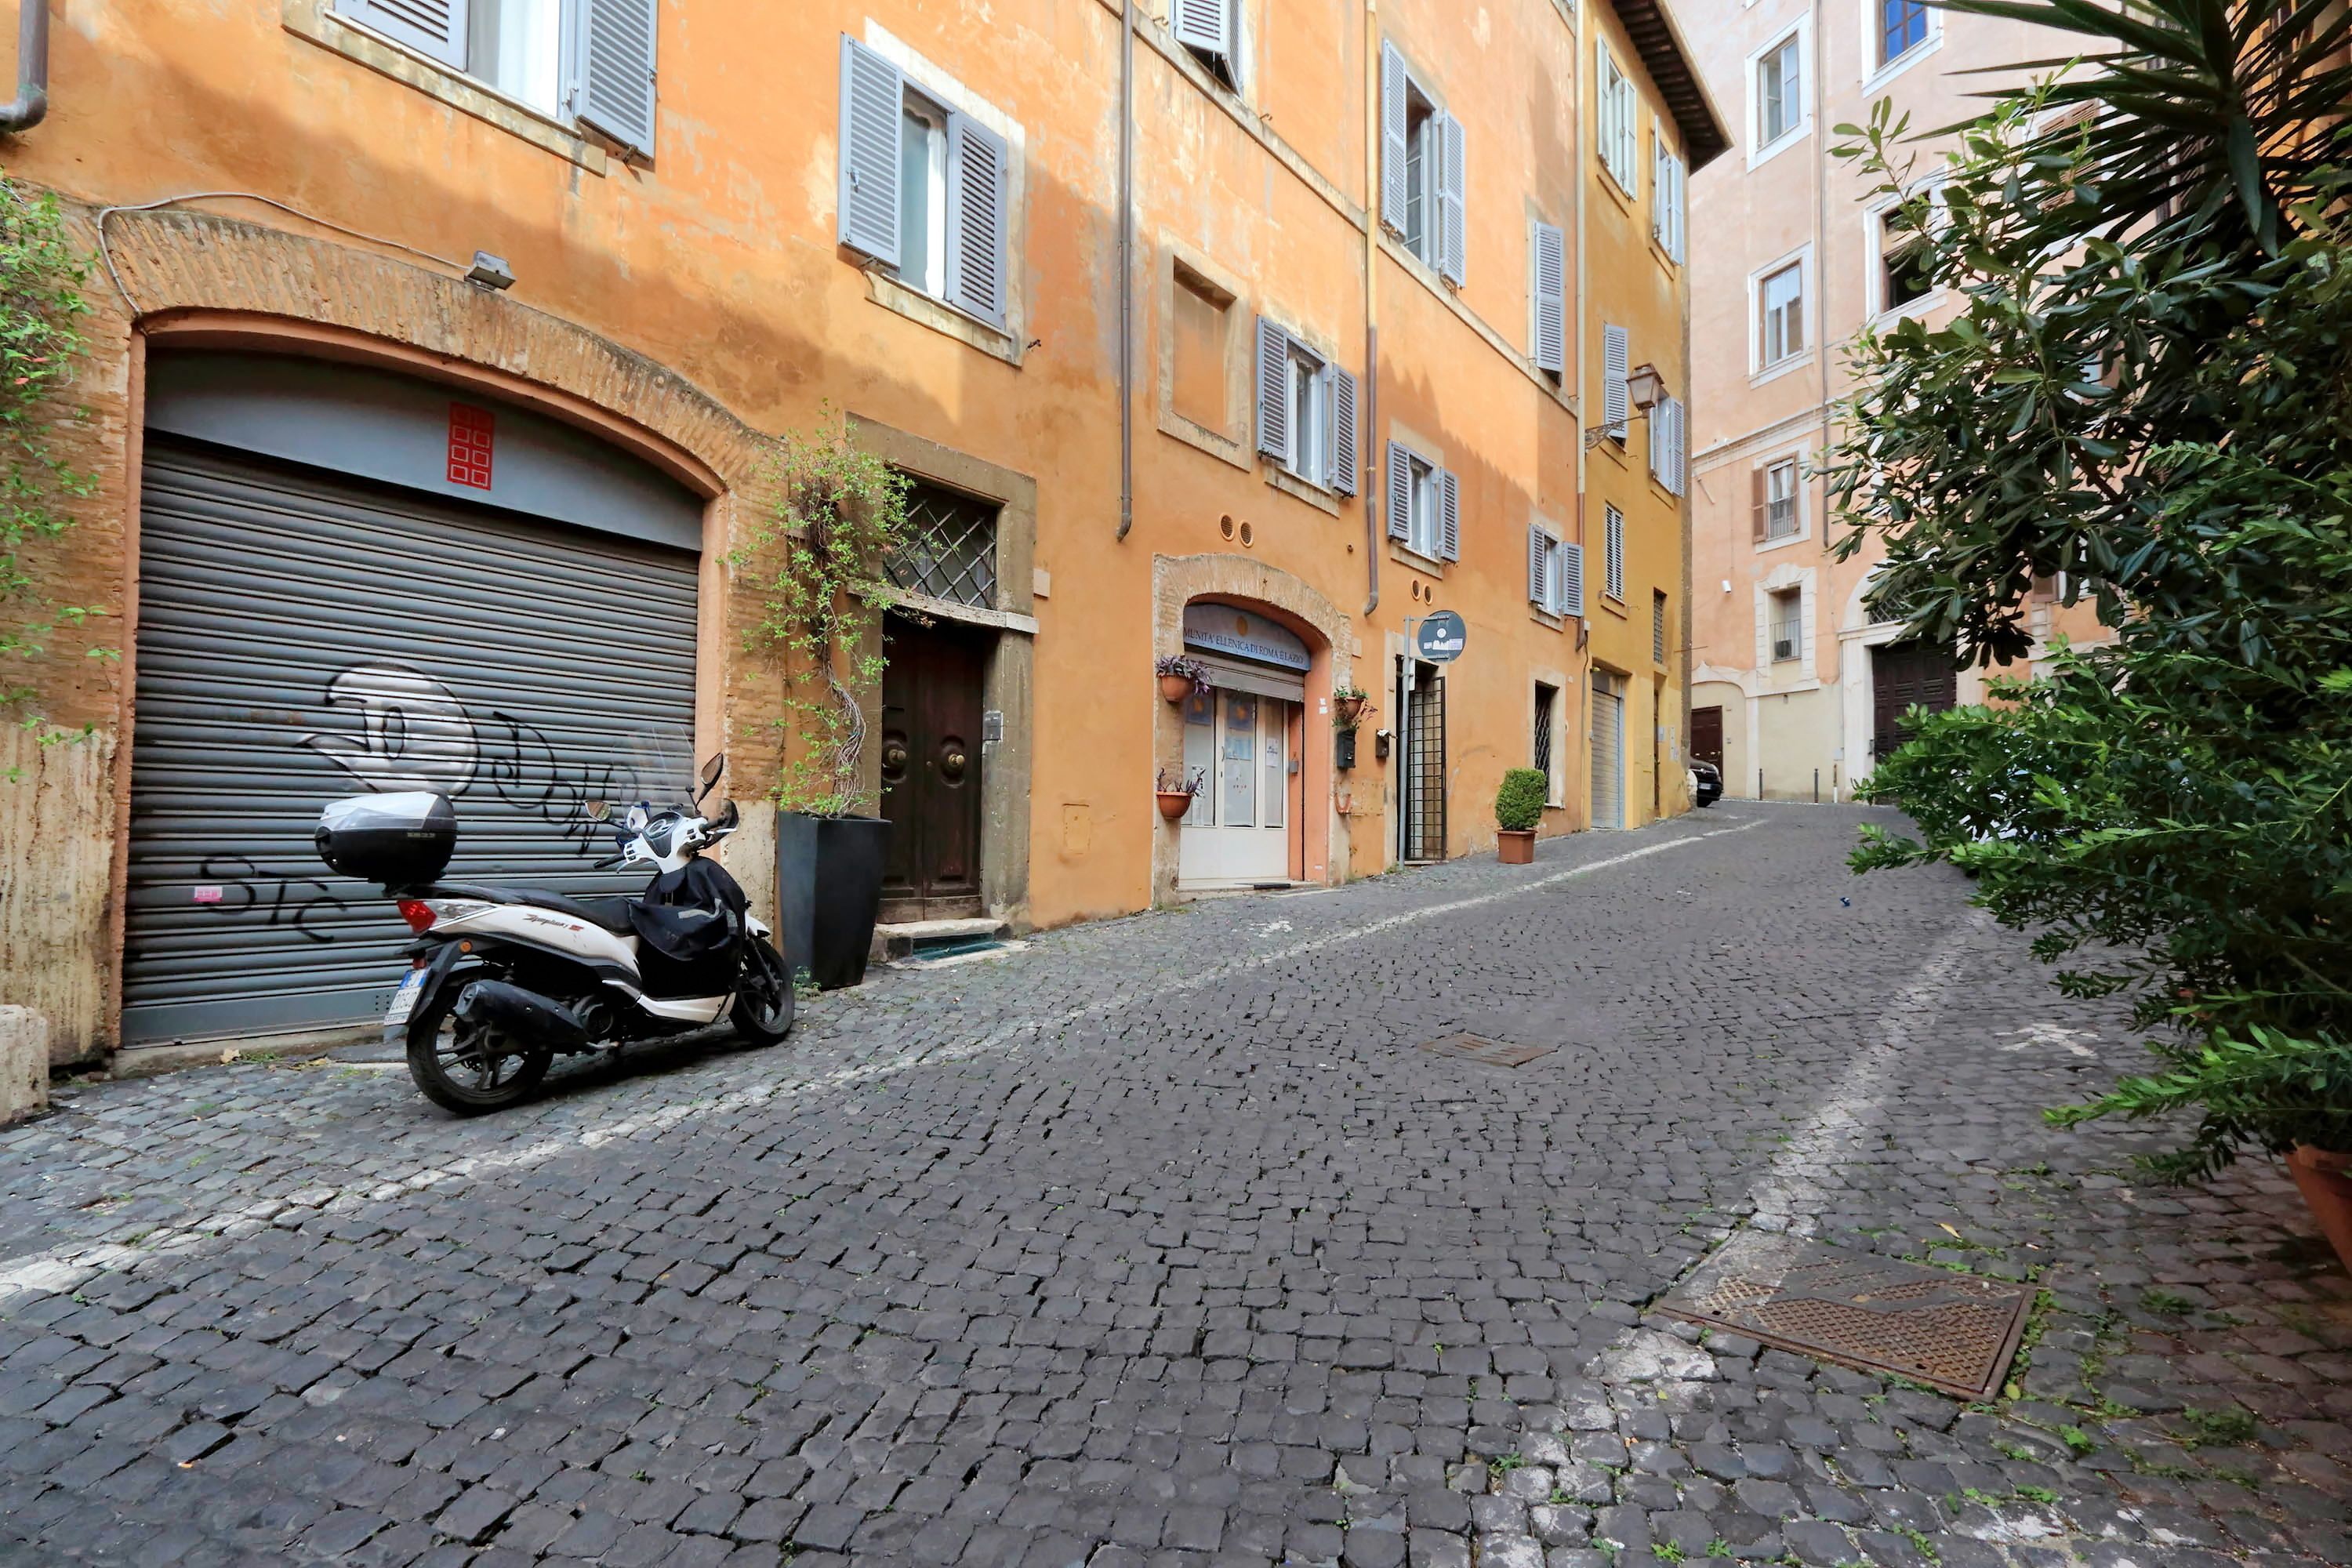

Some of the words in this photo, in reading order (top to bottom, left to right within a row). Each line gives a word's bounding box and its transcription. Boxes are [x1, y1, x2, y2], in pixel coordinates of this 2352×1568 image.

[1216, 634, 1250, 652] ELLENICA
[1250, 643, 1258, 654] DI
[1259, 645, 1279, 659] ROMA
